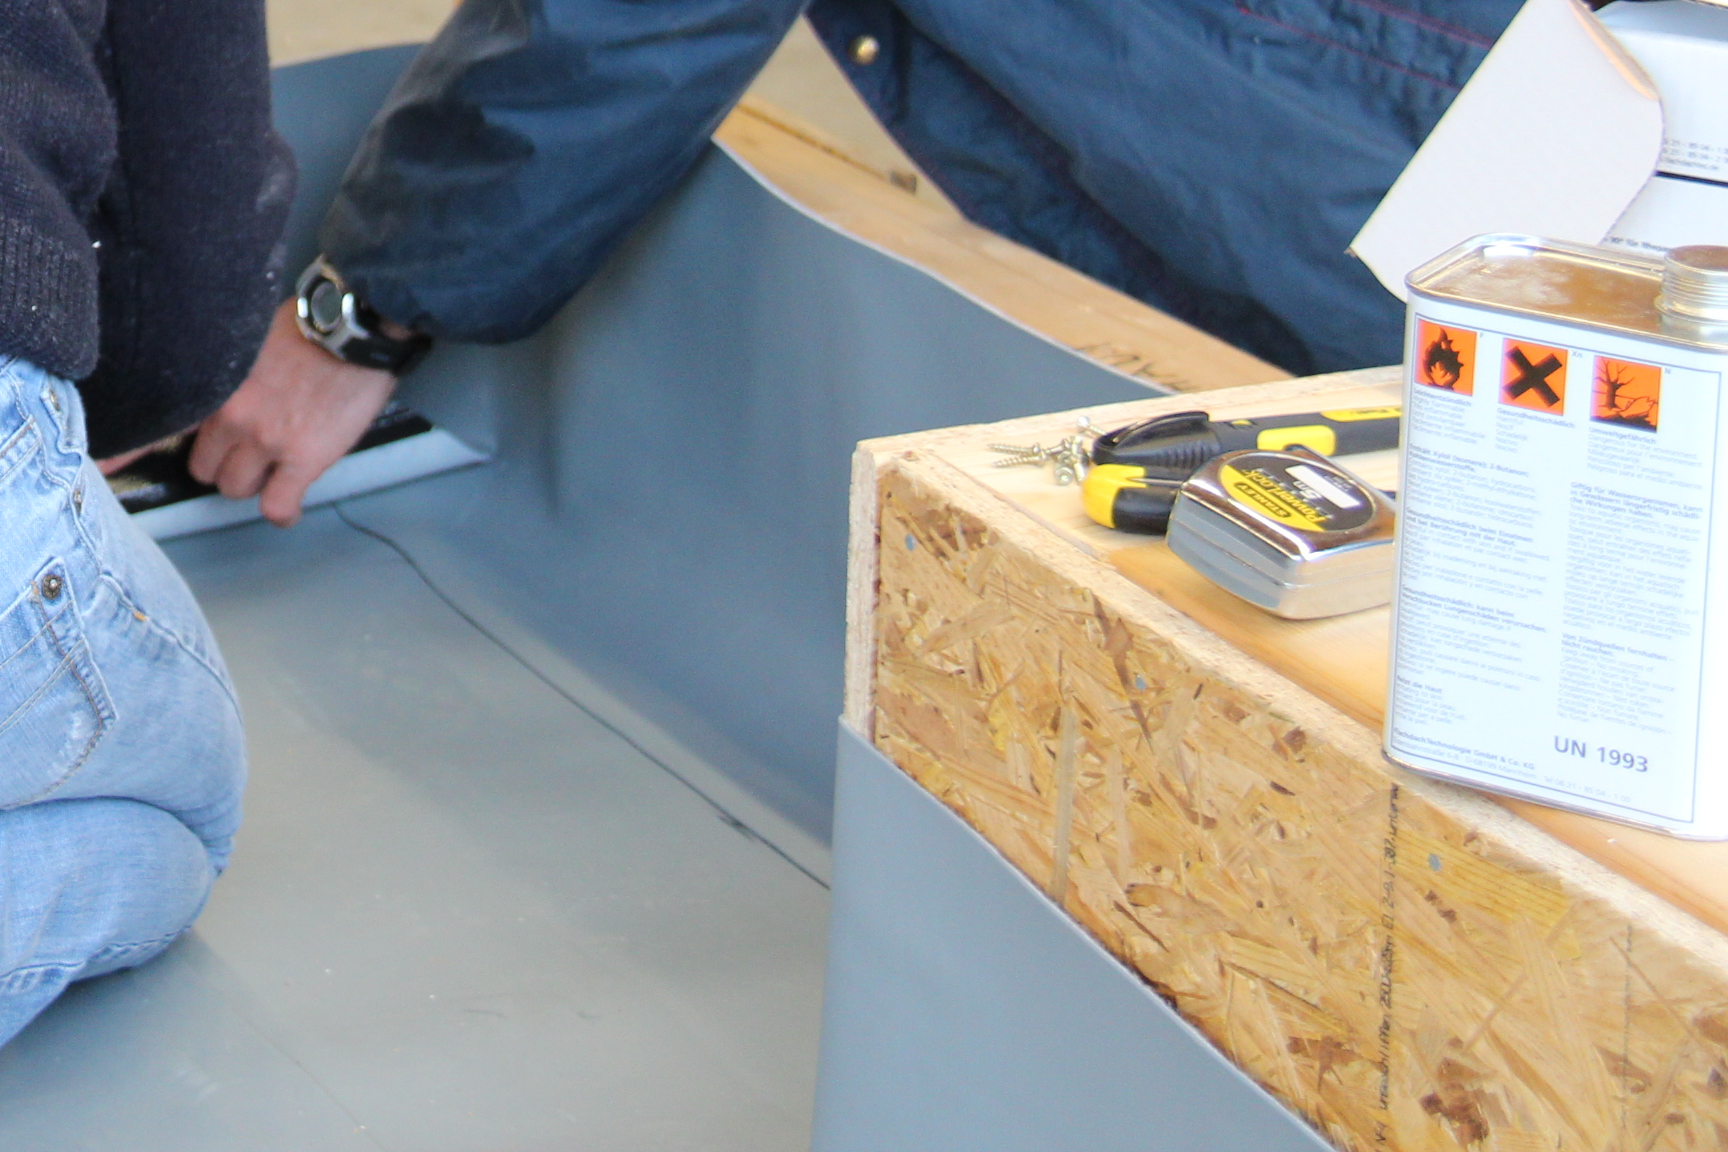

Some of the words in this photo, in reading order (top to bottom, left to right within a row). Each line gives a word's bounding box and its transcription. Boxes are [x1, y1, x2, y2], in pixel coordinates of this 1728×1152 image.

[1236, 483, 1289, 517] STANLEY
[1244, 468, 1327, 523] PowerLock
[1291, 479, 1322, 501] 5m
[1473, 749, 1497, 760] GmbH
[1554, 735, 1586, 758] UN
[1596, 745, 1648, 773] 1993
